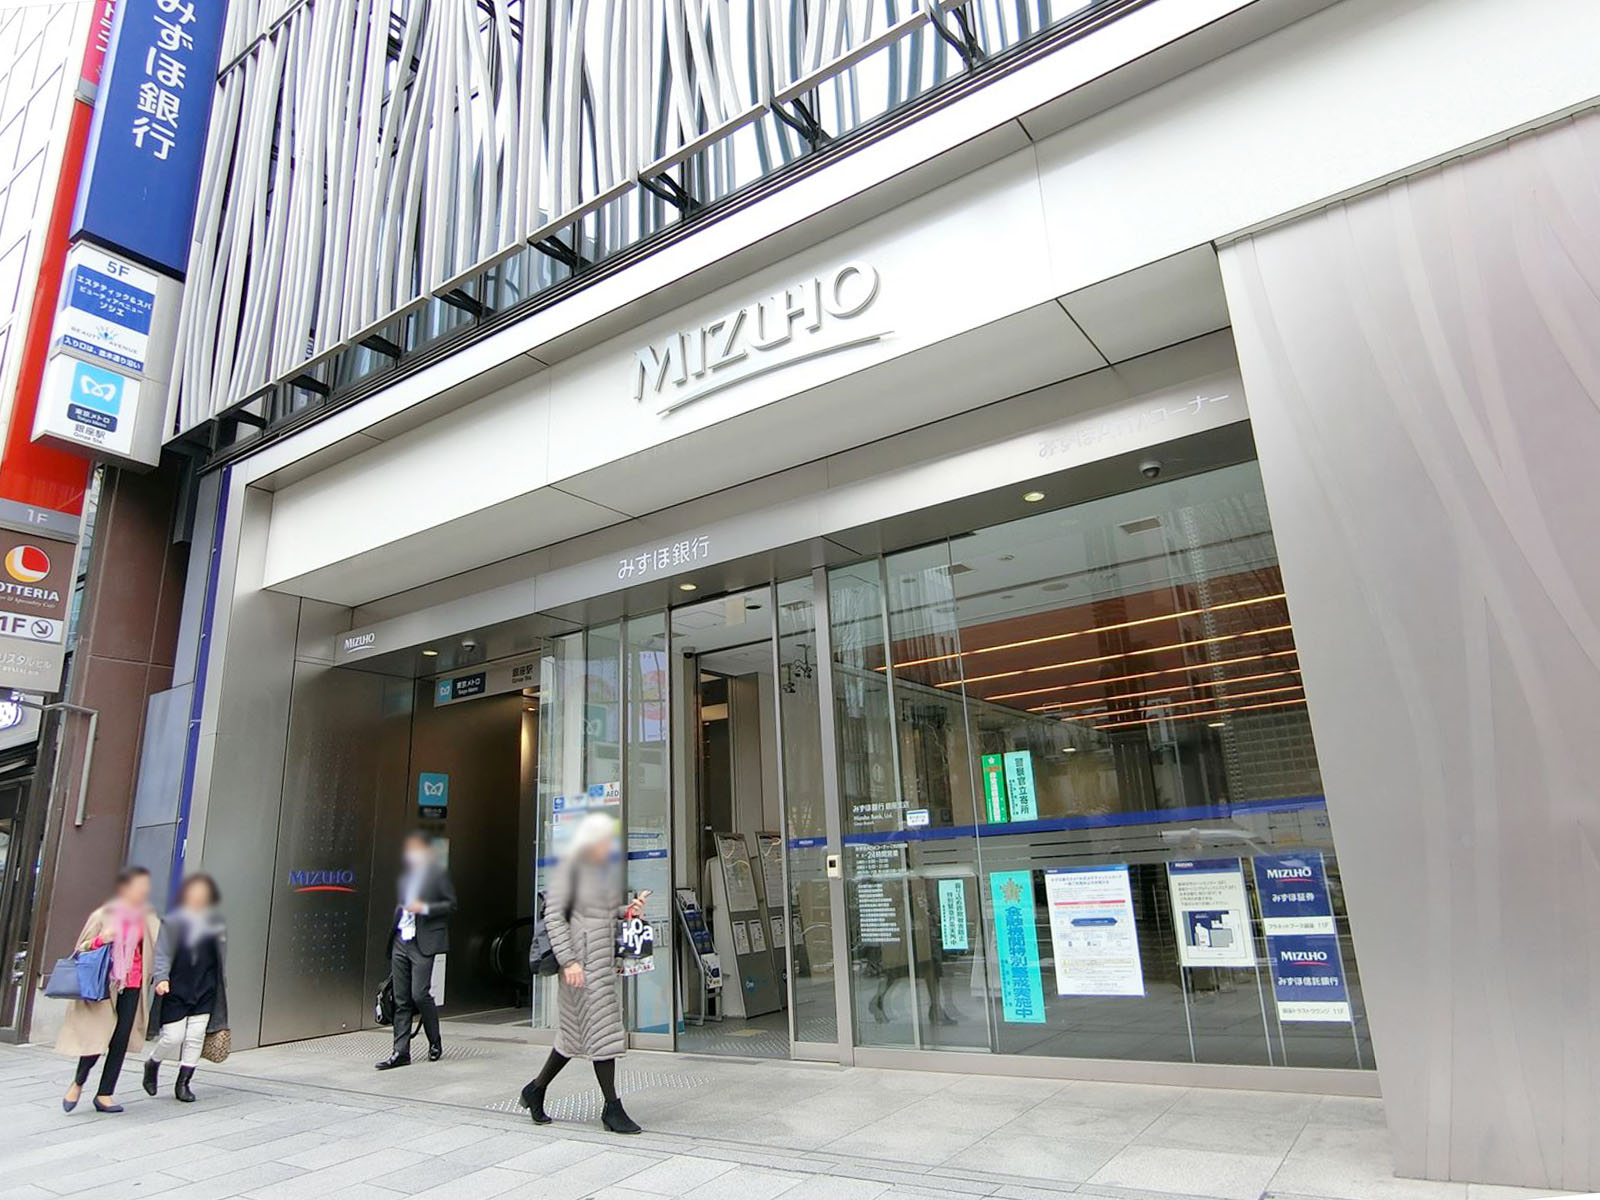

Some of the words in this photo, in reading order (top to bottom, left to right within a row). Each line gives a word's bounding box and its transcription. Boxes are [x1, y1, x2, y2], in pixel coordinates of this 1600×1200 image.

[131, 0, 196, 160] みずほ銀行
[106, 261, 130, 279] 5F
[99, 301, 125, 317] ソシエ
[633, 261, 880, 401] MIZUHO
[74, 424, 106, 440] 銀座駅
[26, 508, 48, 524] 1F
[617, 535, 710, 579] みずほ銀行
[0, 616, 27, 633] 1F
[344, 633, 376, 649] MIZUHO
[606, 790, 619, 798] AED
[288, 870, 354, 886] MIZUHO
[1267, 868, 1312, 879] MIZUHO
[1271, 892, 1315, 903] みずほ証券
[1280, 951, 1328, 961] MIZUHO
[1277, 976, 1339, 987] みずほ信託銀行
